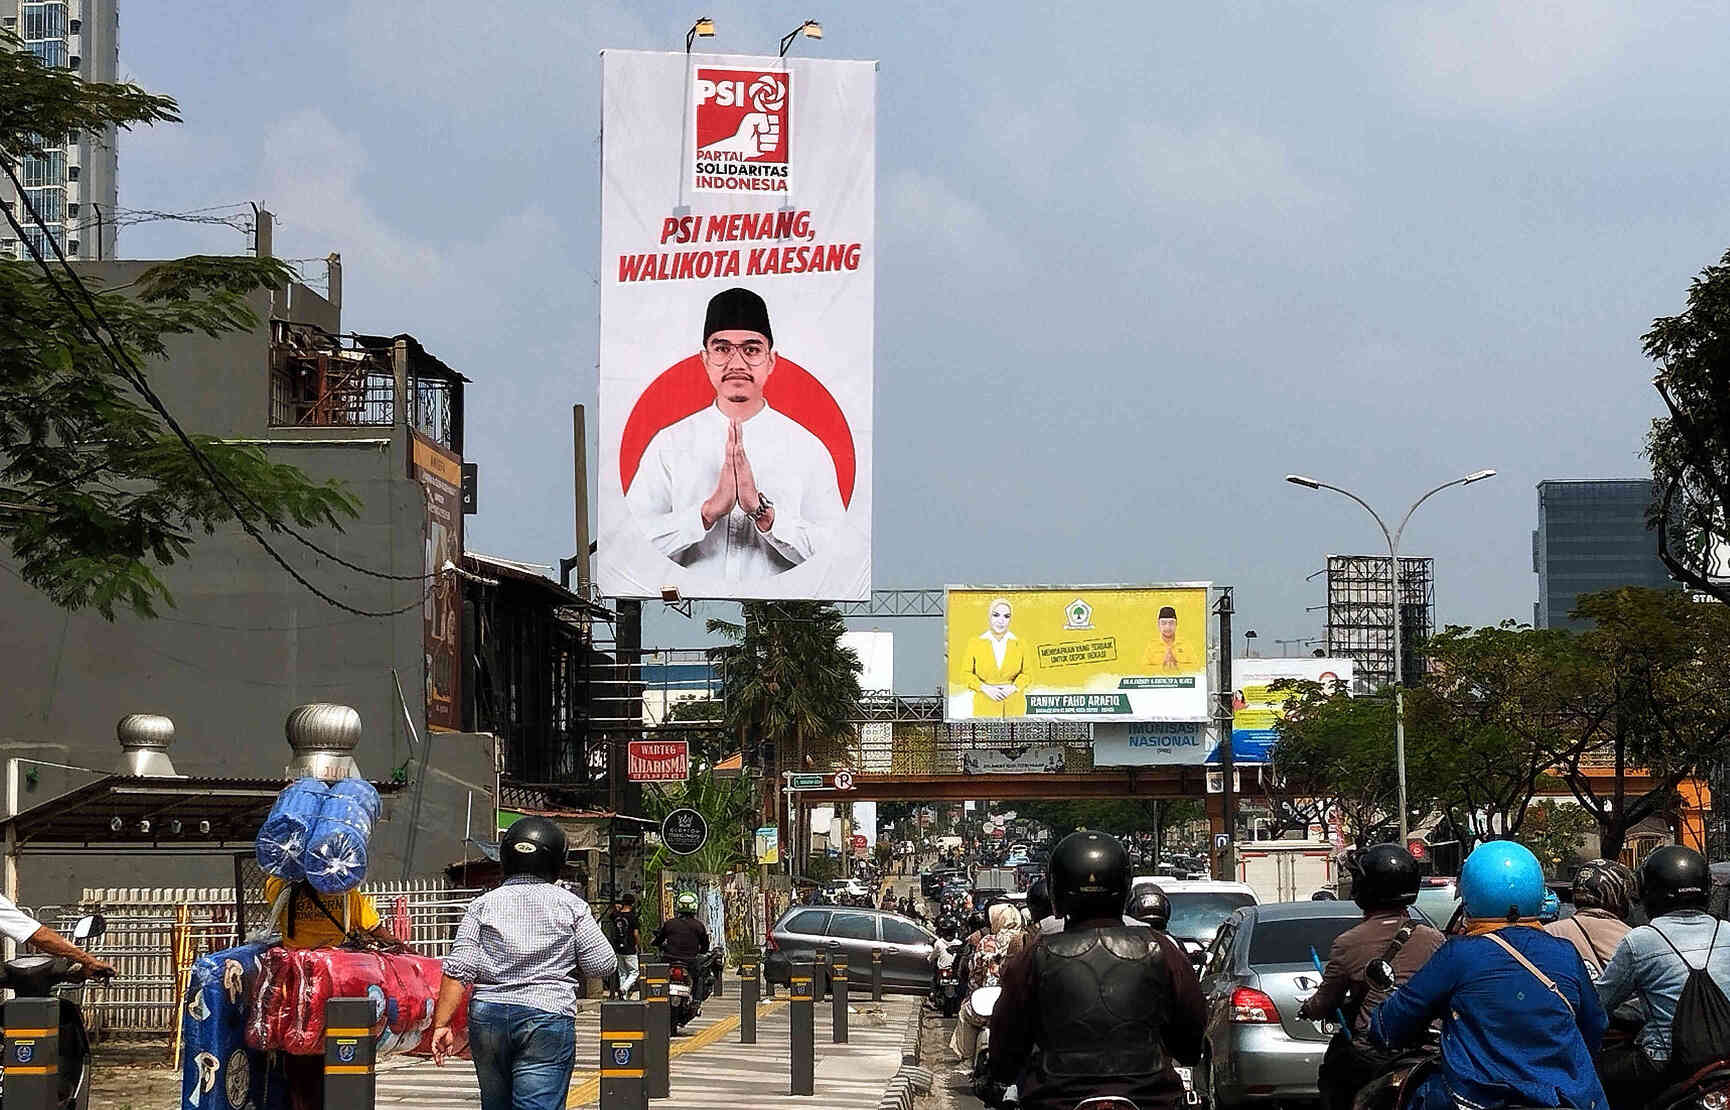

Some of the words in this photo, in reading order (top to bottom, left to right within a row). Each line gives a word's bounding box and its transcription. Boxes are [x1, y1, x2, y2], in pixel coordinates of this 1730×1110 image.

[697, 80, 745, 107] PSI
[696, 151, 743, 162] PARTAI
[696, 163, 788, 177] SOLIDARITAS
[696, 176, 788, 191] INDONESIA
[660, 215, 702, 245] PSI
[704, 211, 816, 243] MENANG,
[618, 250, 740, 282] WALIKOTA
[746, 243, 862, 276] KAESANG
[1030, 695, 1060, 707] RANNY
[1128, 723, 1199, 735] IMUNISASI
[1129, 736, 1199, 747] NASIONAL
[641, 744, 676, 755] WARTEG
[631, 753, 686, 773] KHARISMA
